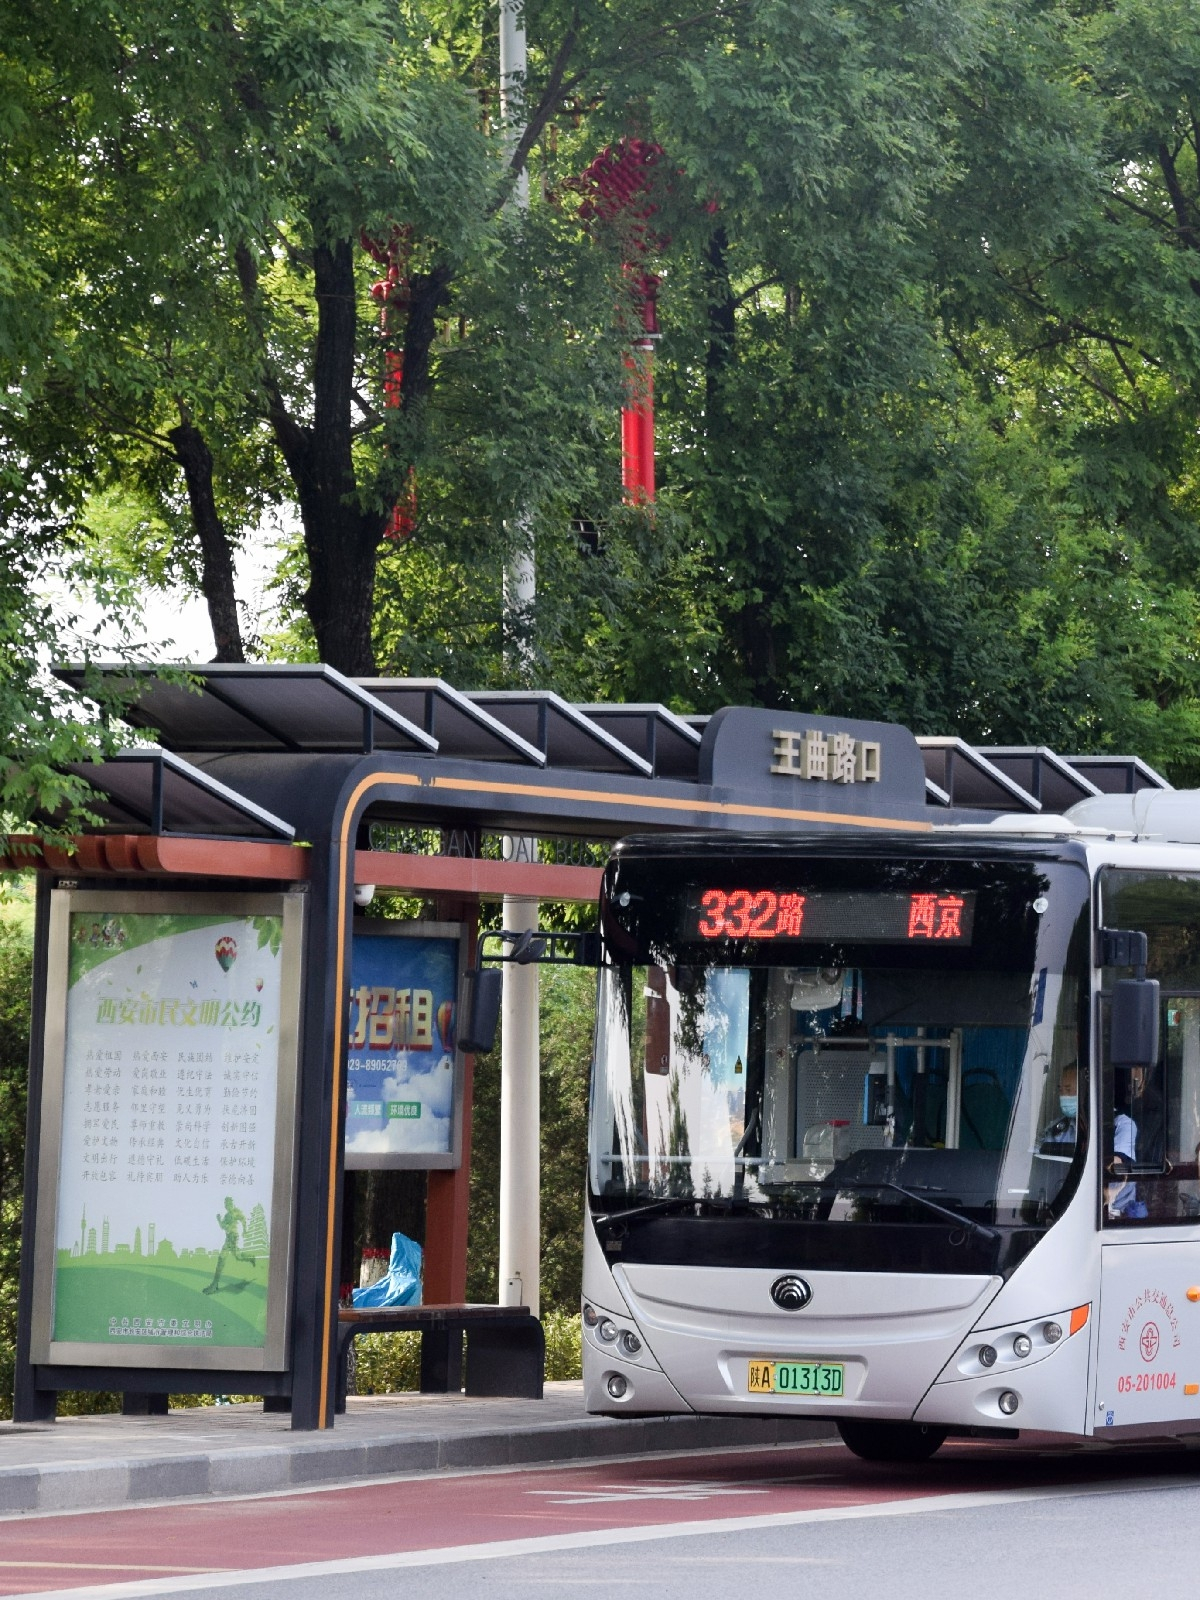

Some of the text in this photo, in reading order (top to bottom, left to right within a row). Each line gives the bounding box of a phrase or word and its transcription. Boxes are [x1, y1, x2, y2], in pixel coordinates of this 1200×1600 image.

[770, 729, 881, 784] 王曲路口
[699, 890, 965, 938] 332路 西京
[96, 999, 261, 1027] 西安市民文明公约
[350, 986, 433, 1050] 招租
[1118, 1372, 1177, 1393] 05-201004
